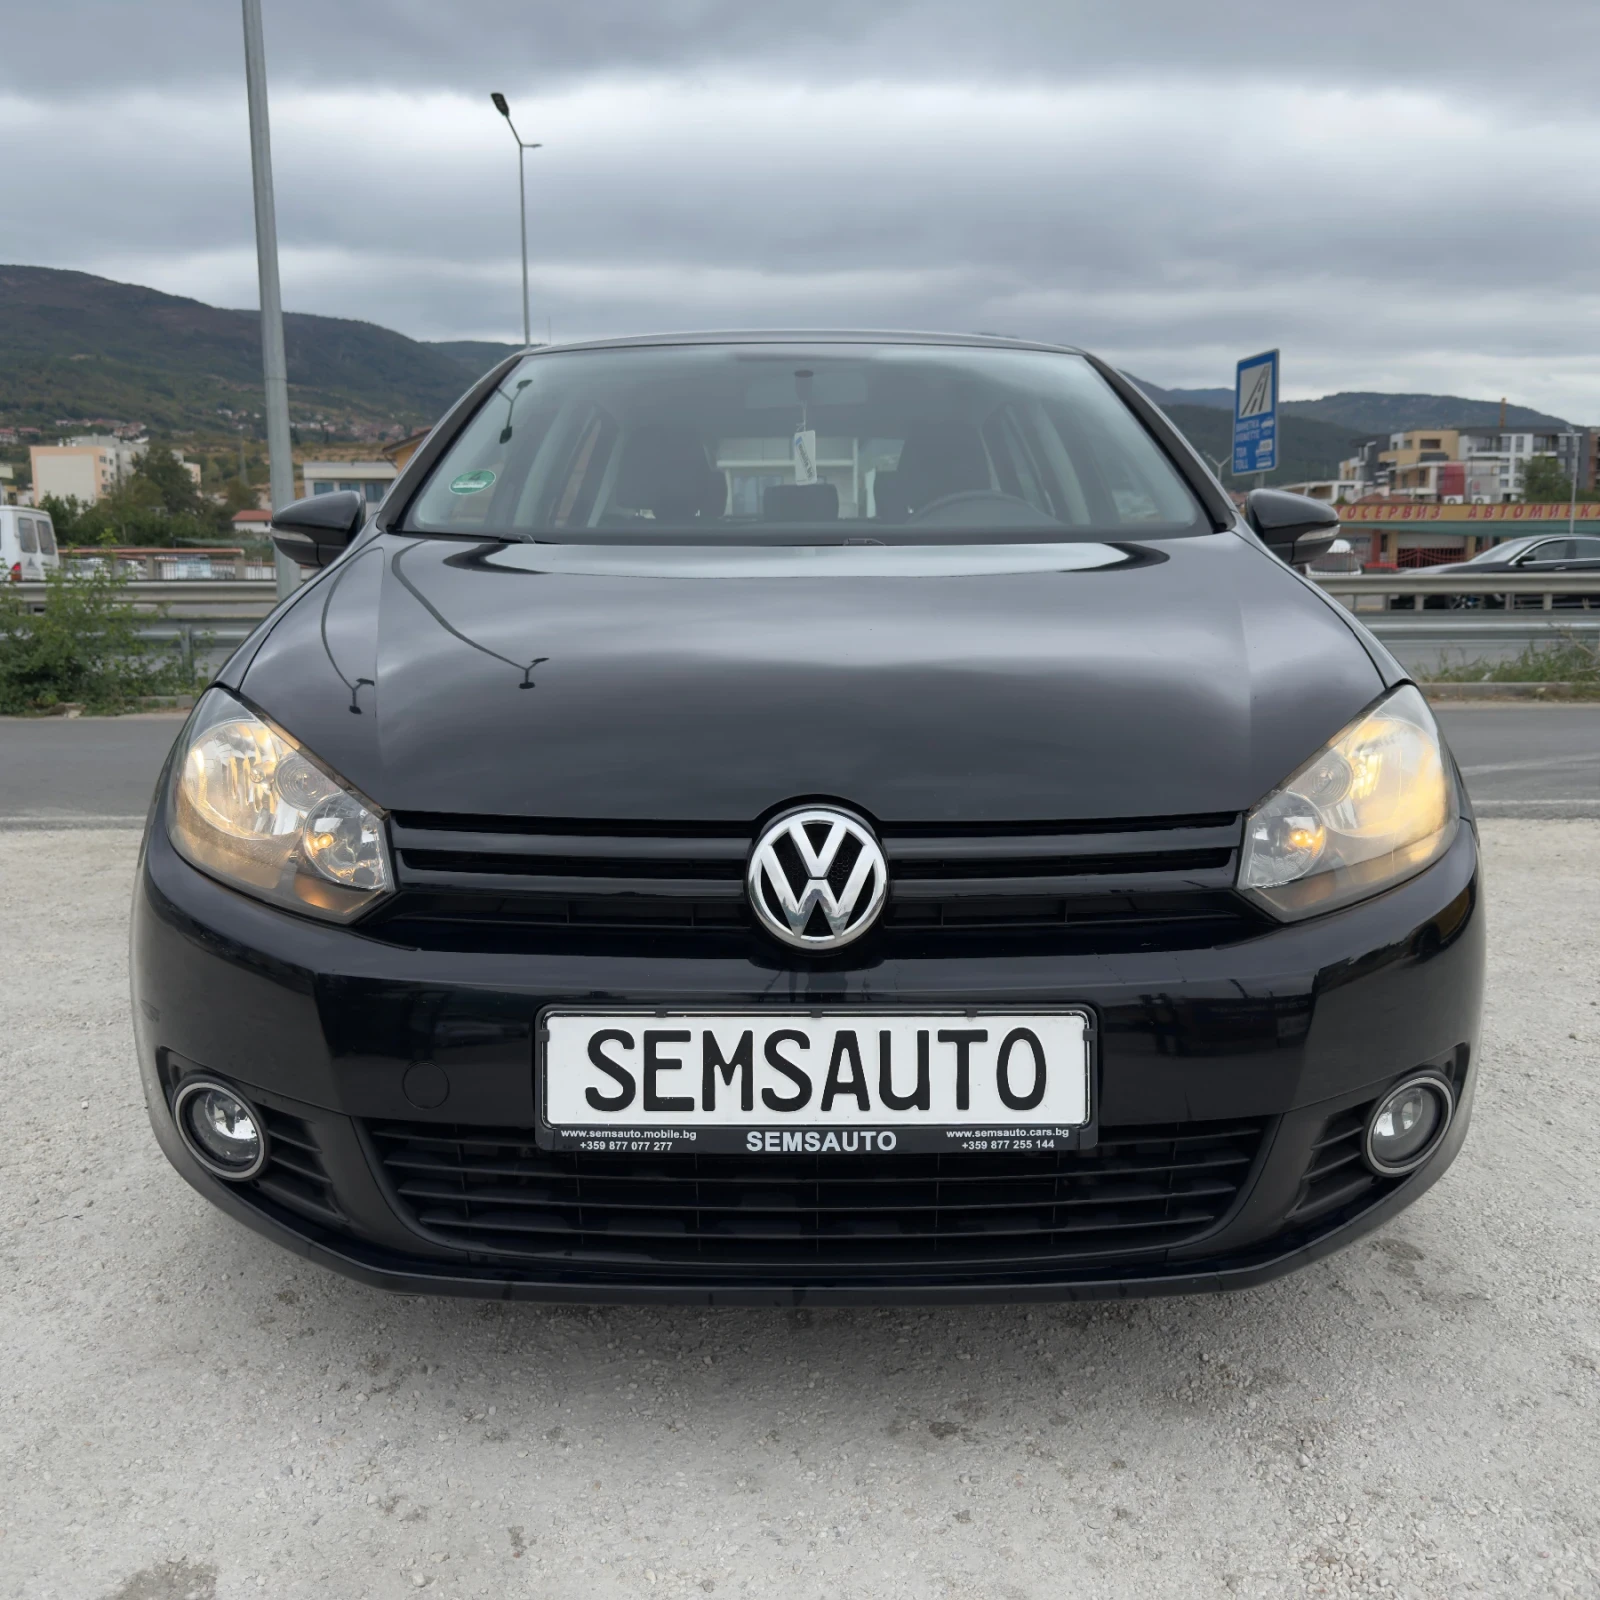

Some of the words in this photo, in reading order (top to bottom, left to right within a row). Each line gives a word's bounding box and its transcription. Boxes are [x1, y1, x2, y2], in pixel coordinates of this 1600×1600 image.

[585, 1028, 1047, 1112] SEMSAUTO
[561, 1130, 697, 1140] www.semsauto.mobile.bg
[946, 1128, 1069, 1138] www.semsauto.cars.bg
[579, 1141, 606, 1151] +359
[608, 1141, 628, 1151] 877
[631, 1141, 651, 1151] 077
[653, 1141, 673, 1151] 277
[746, 1131, 897, 1152] SEMSAUTO
[961, 1140, 988, 1150] +359
[990, 1140, 1010, 1150] 877
[1012, 1140, 1033, 1150] 255
[1036, 1139, 1055, 1149] 144
